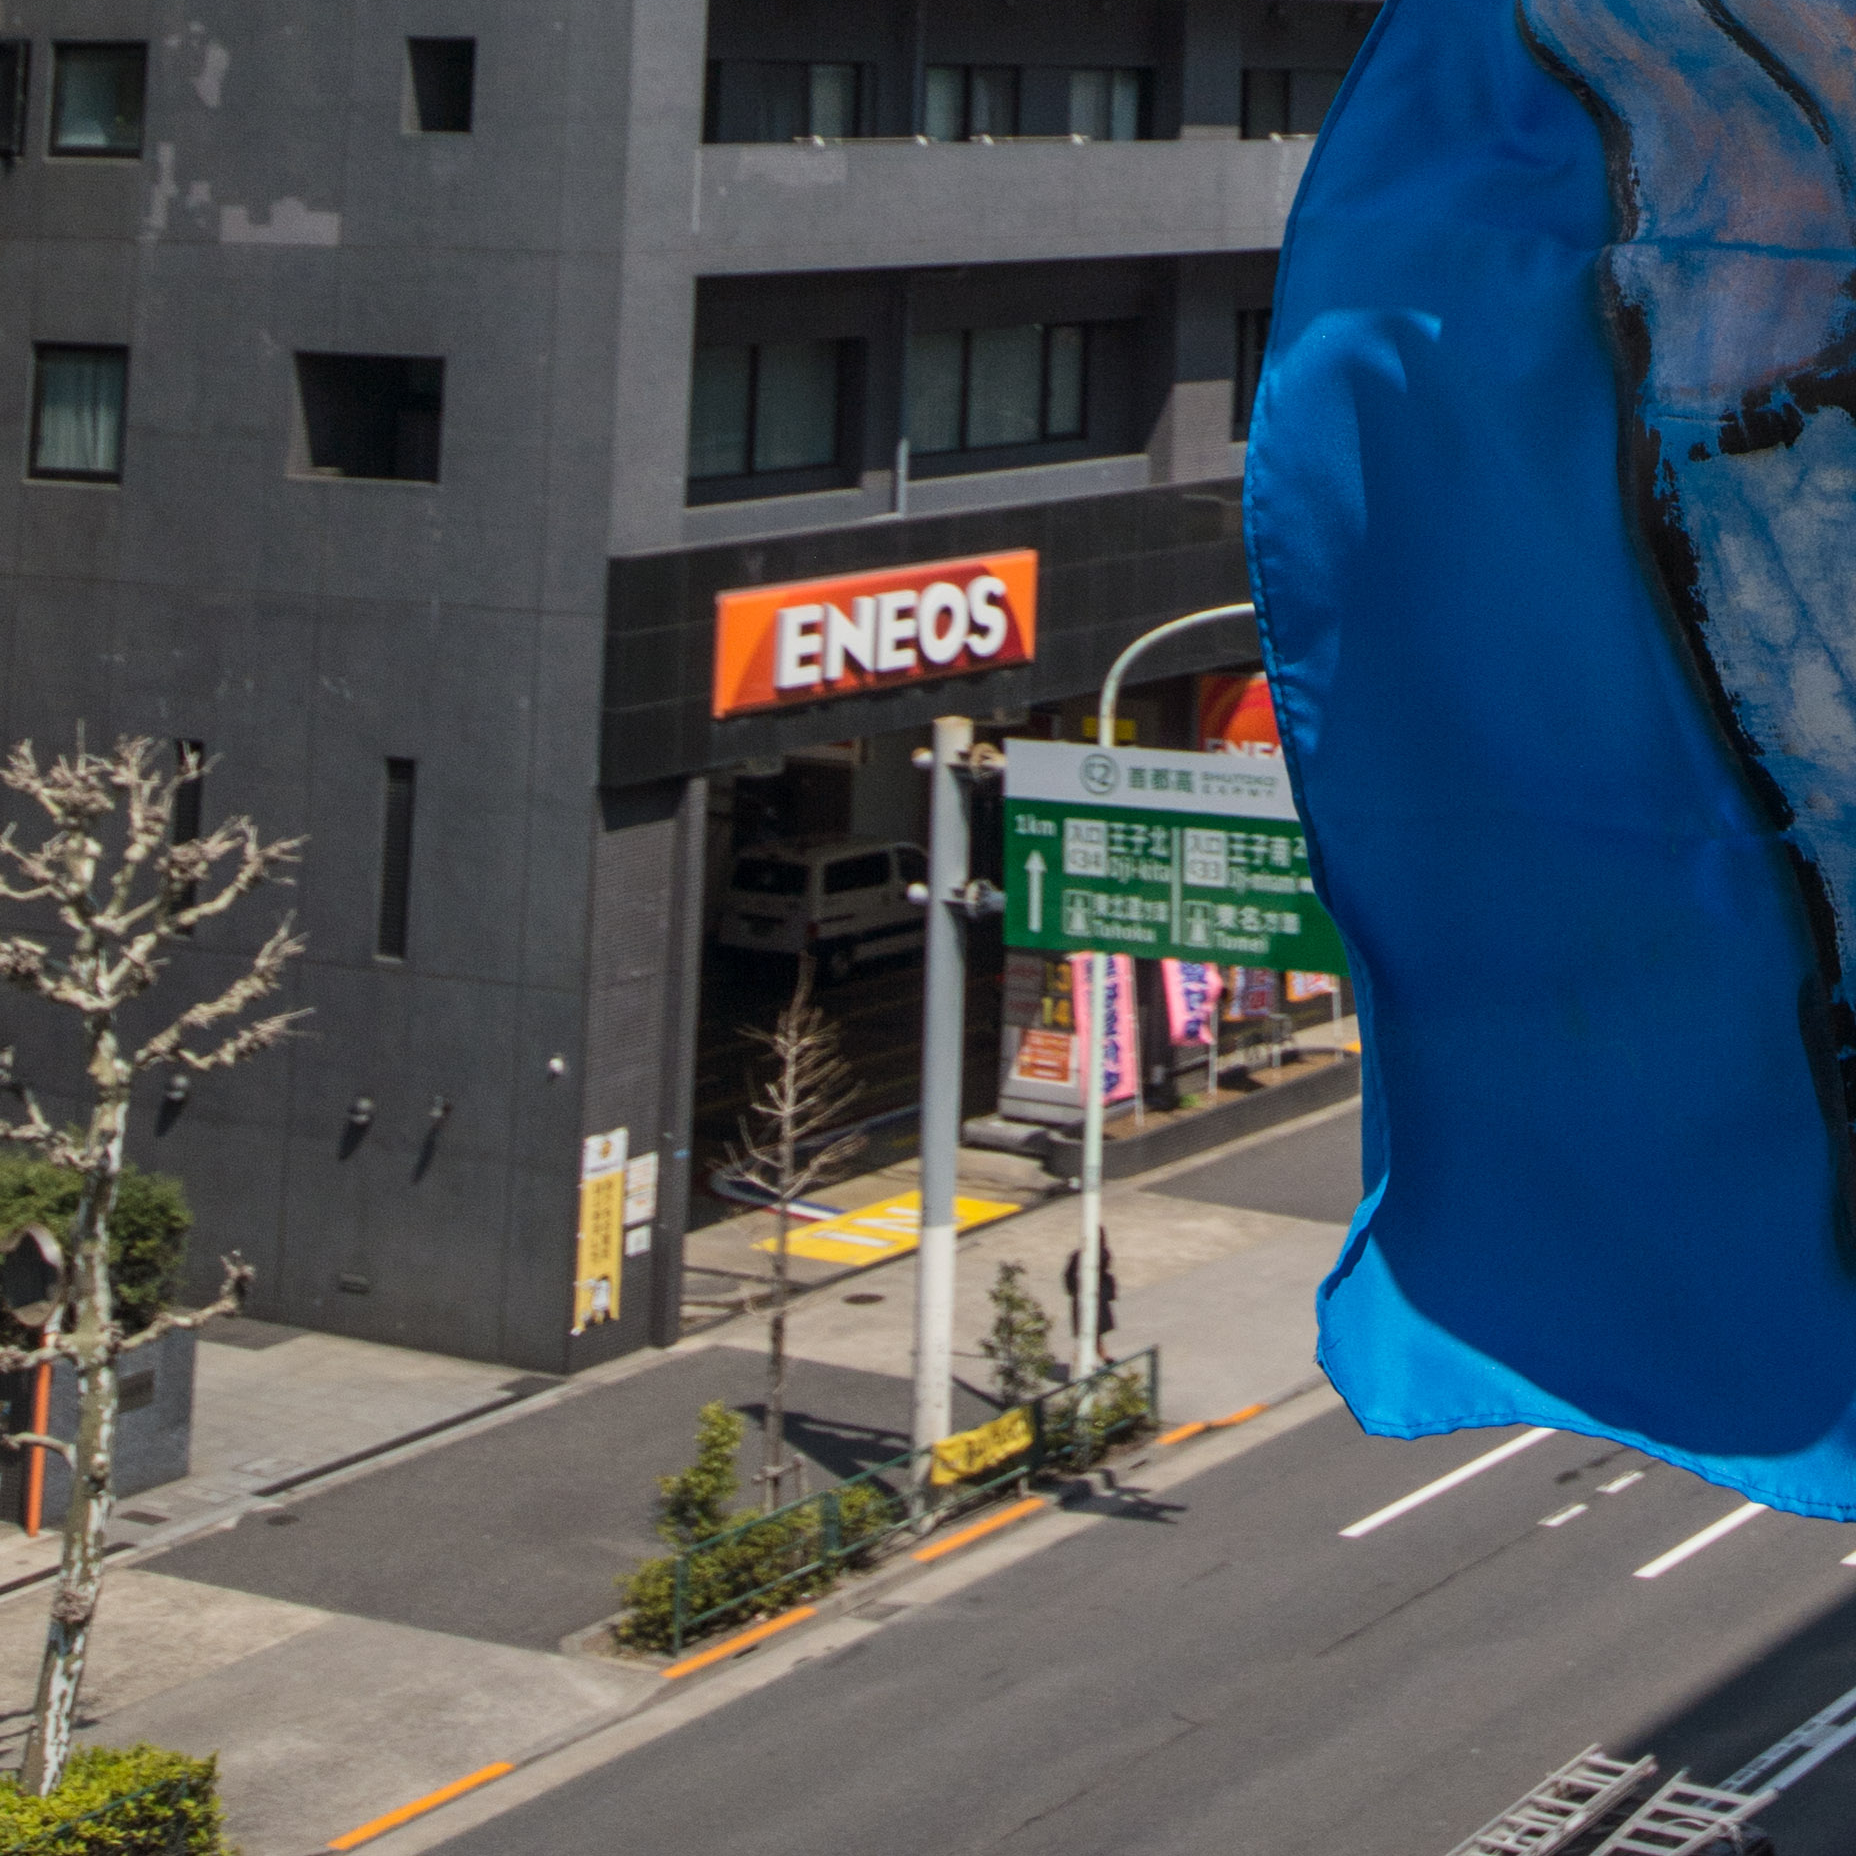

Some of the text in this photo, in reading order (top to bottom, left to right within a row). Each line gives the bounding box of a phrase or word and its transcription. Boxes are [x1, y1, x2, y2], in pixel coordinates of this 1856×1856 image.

[774, 574, 1009, 690] ENEOS
[1128, 766, 1194, 794] 首都高
